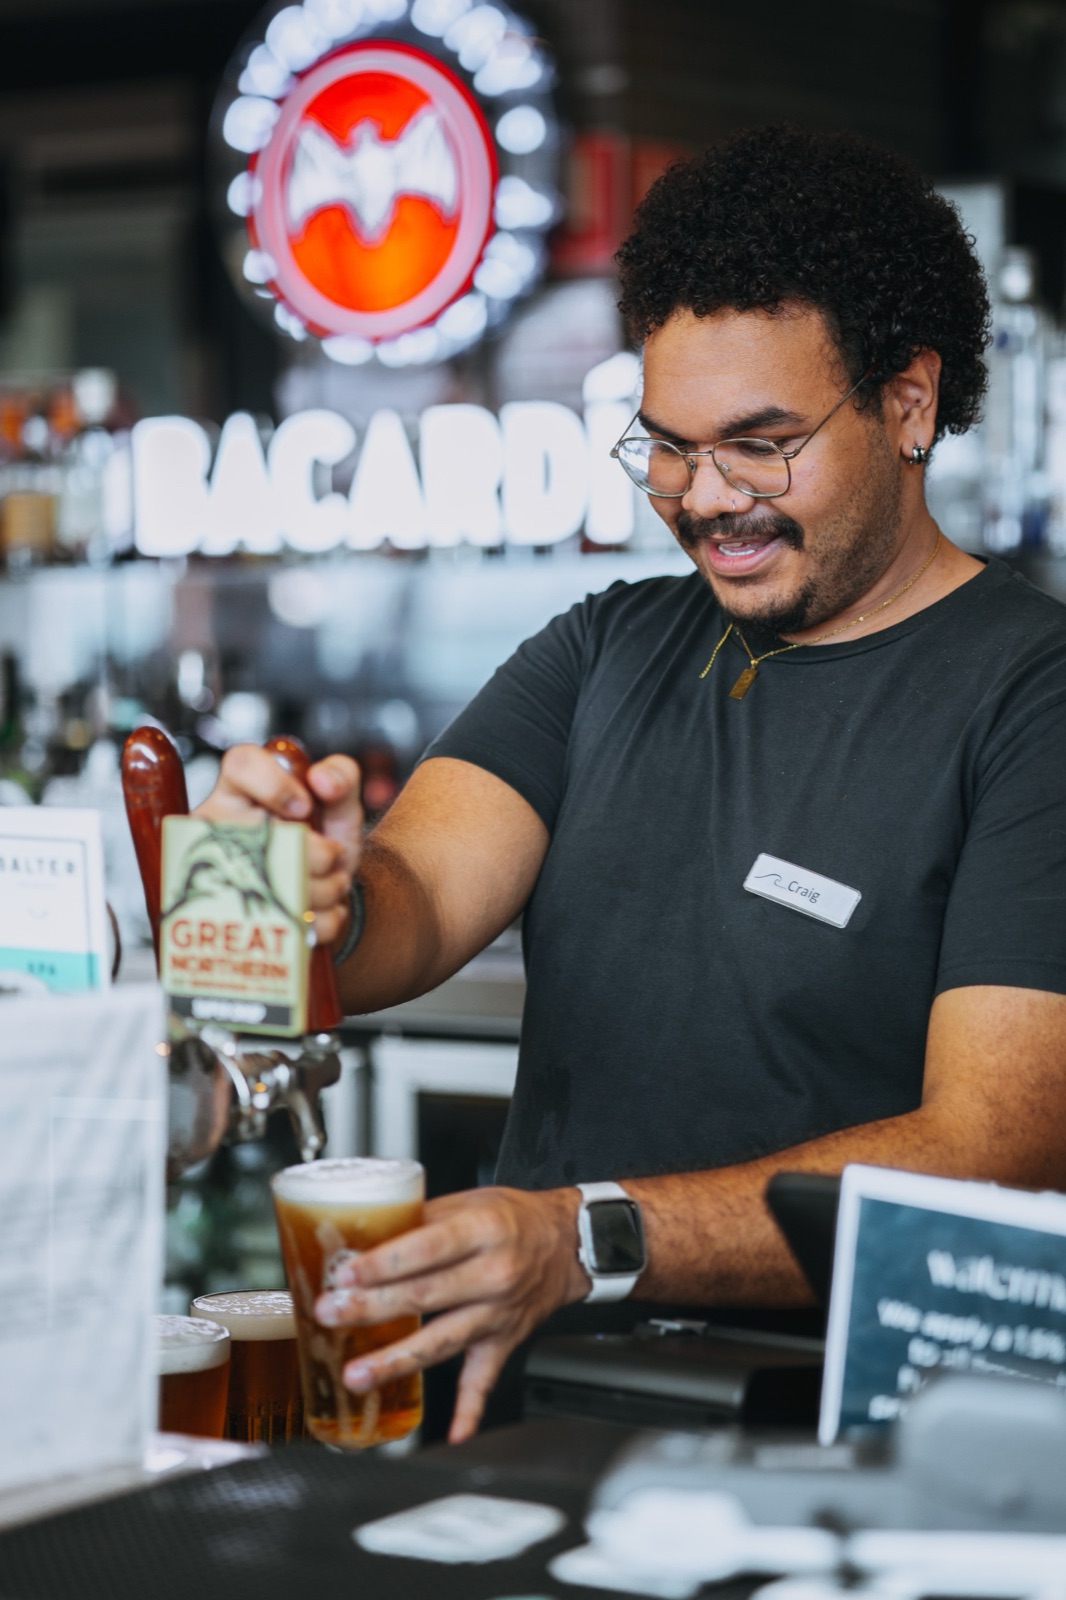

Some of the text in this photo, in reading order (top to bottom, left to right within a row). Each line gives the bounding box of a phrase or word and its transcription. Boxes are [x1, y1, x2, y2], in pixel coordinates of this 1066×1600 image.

[787, 880, 821, 904] Craig
[171, 919, 287, 955] GREAT
[171, 956, 288, 979] NORTHERN
